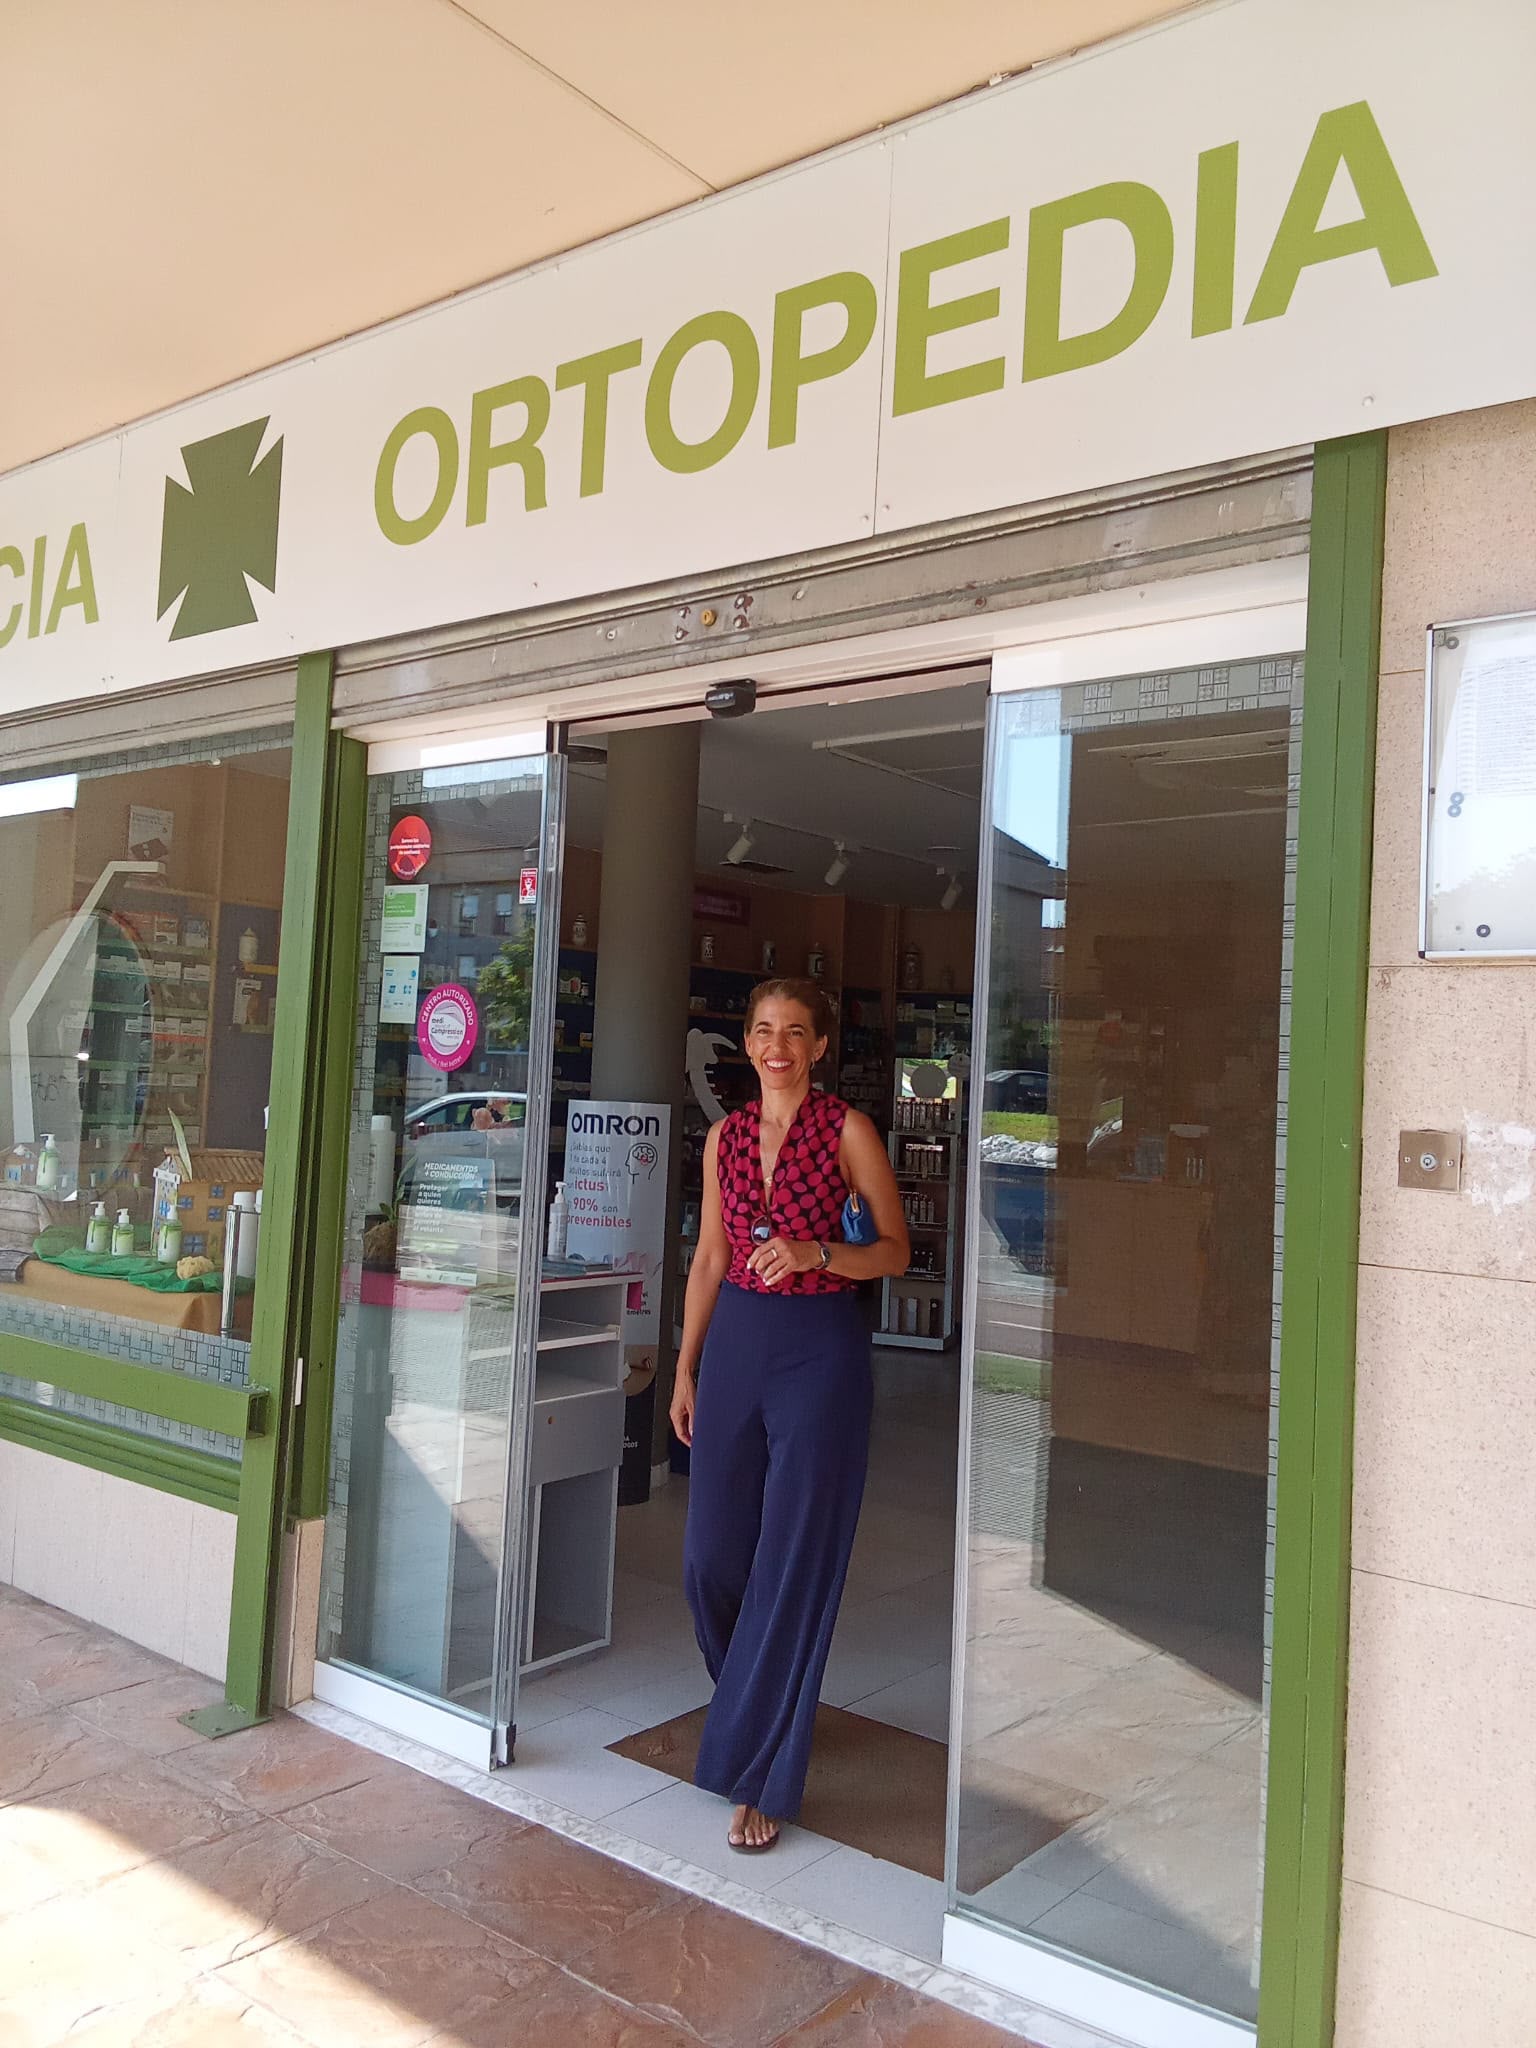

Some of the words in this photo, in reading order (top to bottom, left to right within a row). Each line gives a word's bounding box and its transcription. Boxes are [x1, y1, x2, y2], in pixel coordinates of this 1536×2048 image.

[374, 101, 1438, 545] ORTOPEDIA
[421, 992, 442, 1023] CENTRO
[442, 989, 474, 1026] AUTORIZADO
[431, 1027, 463, 1036] Compression
[424, 1162, 479, 1173] MEDICAMENTOS
[430, 1170, 475, 1180] CONDUCCIÓN
[419, 1183, 448, 1192] Proteger
[573, 1197, 598, 1212] 90%
[602, 1205, 618, 1213] son
